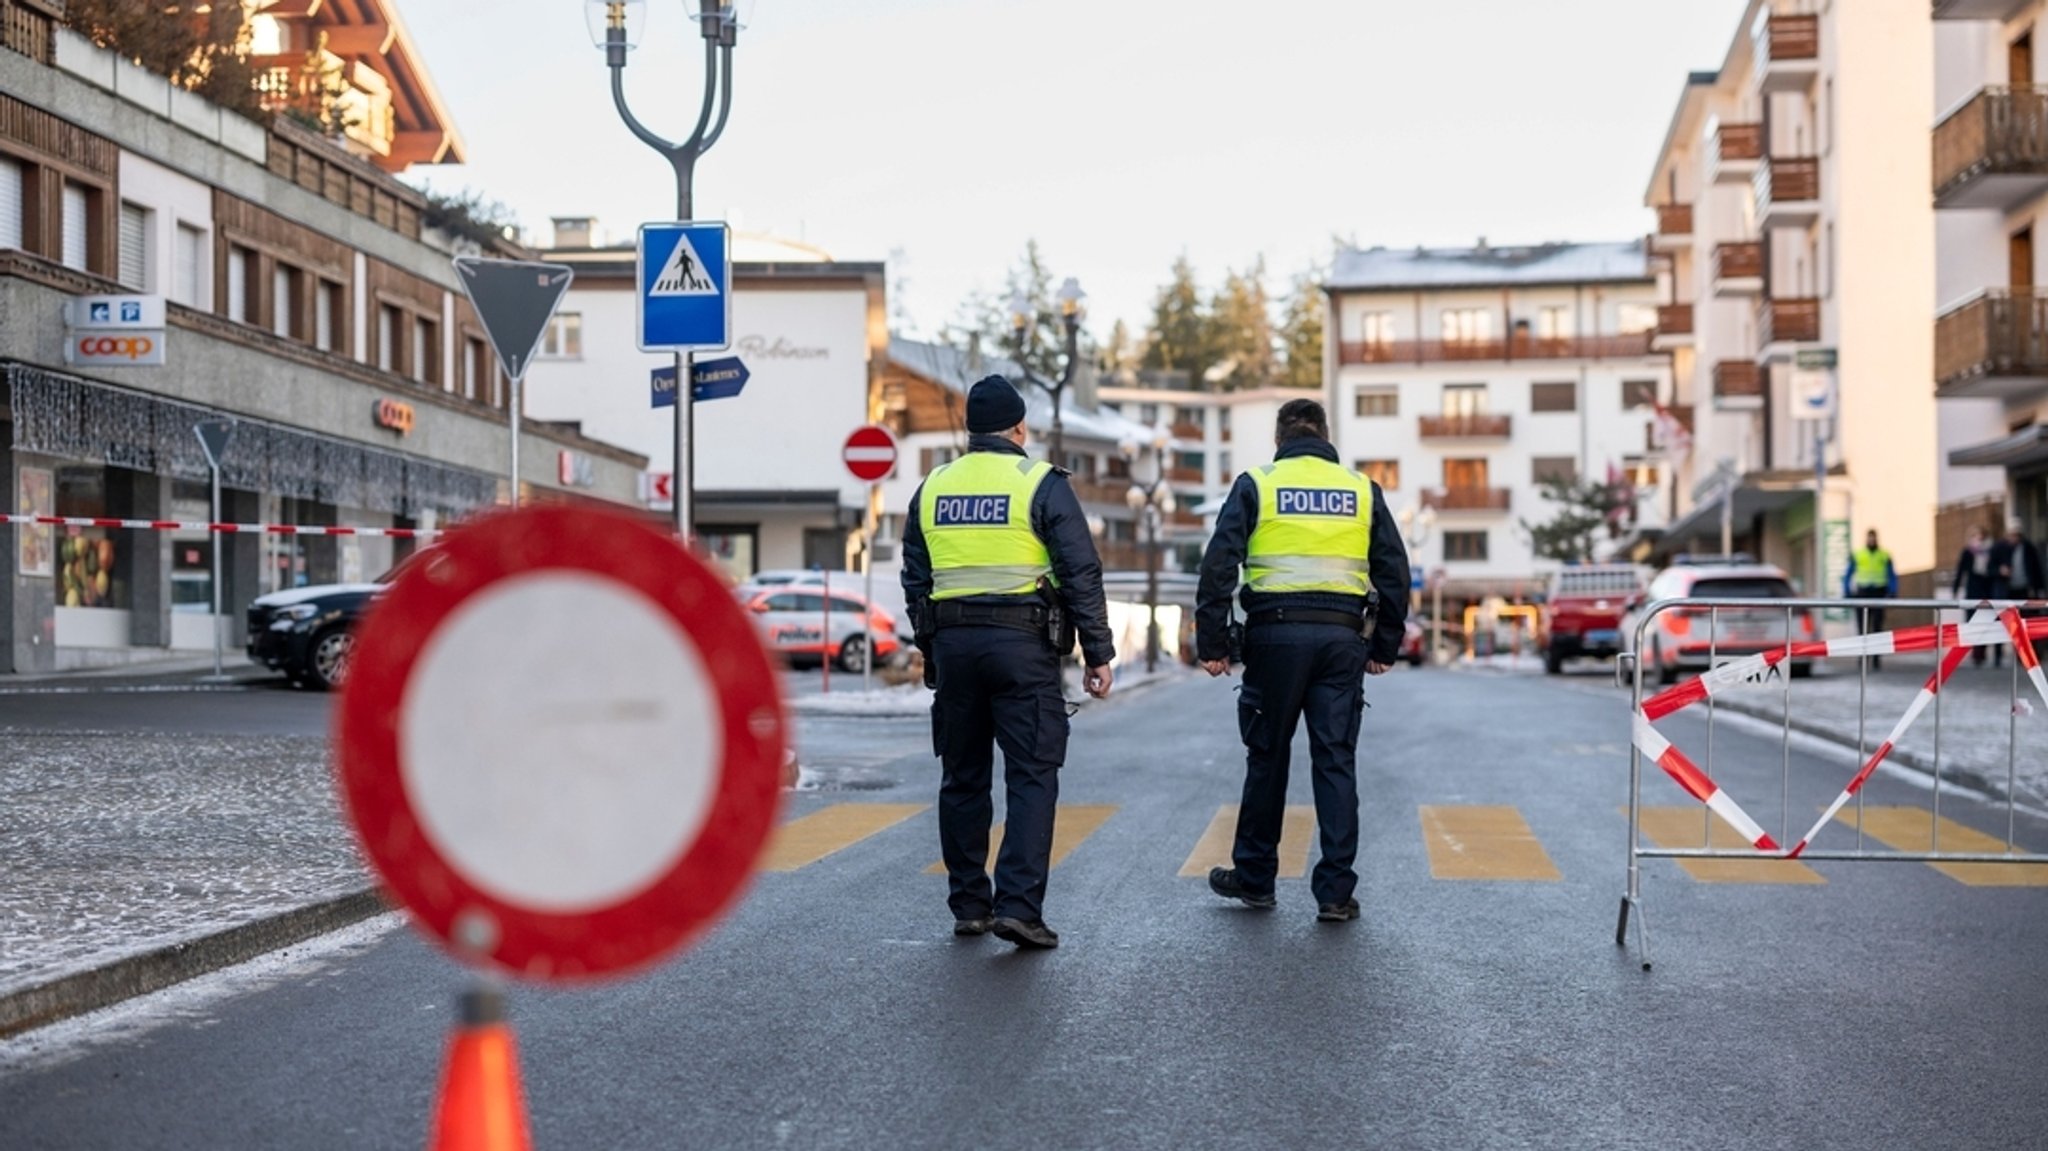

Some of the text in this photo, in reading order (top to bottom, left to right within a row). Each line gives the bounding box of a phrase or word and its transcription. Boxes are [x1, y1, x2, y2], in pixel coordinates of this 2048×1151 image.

[80, 336, 153, 360] coop
[937, 498, 1006, 522] POLICE
[1280, 491, 1354, 513] POLICE
